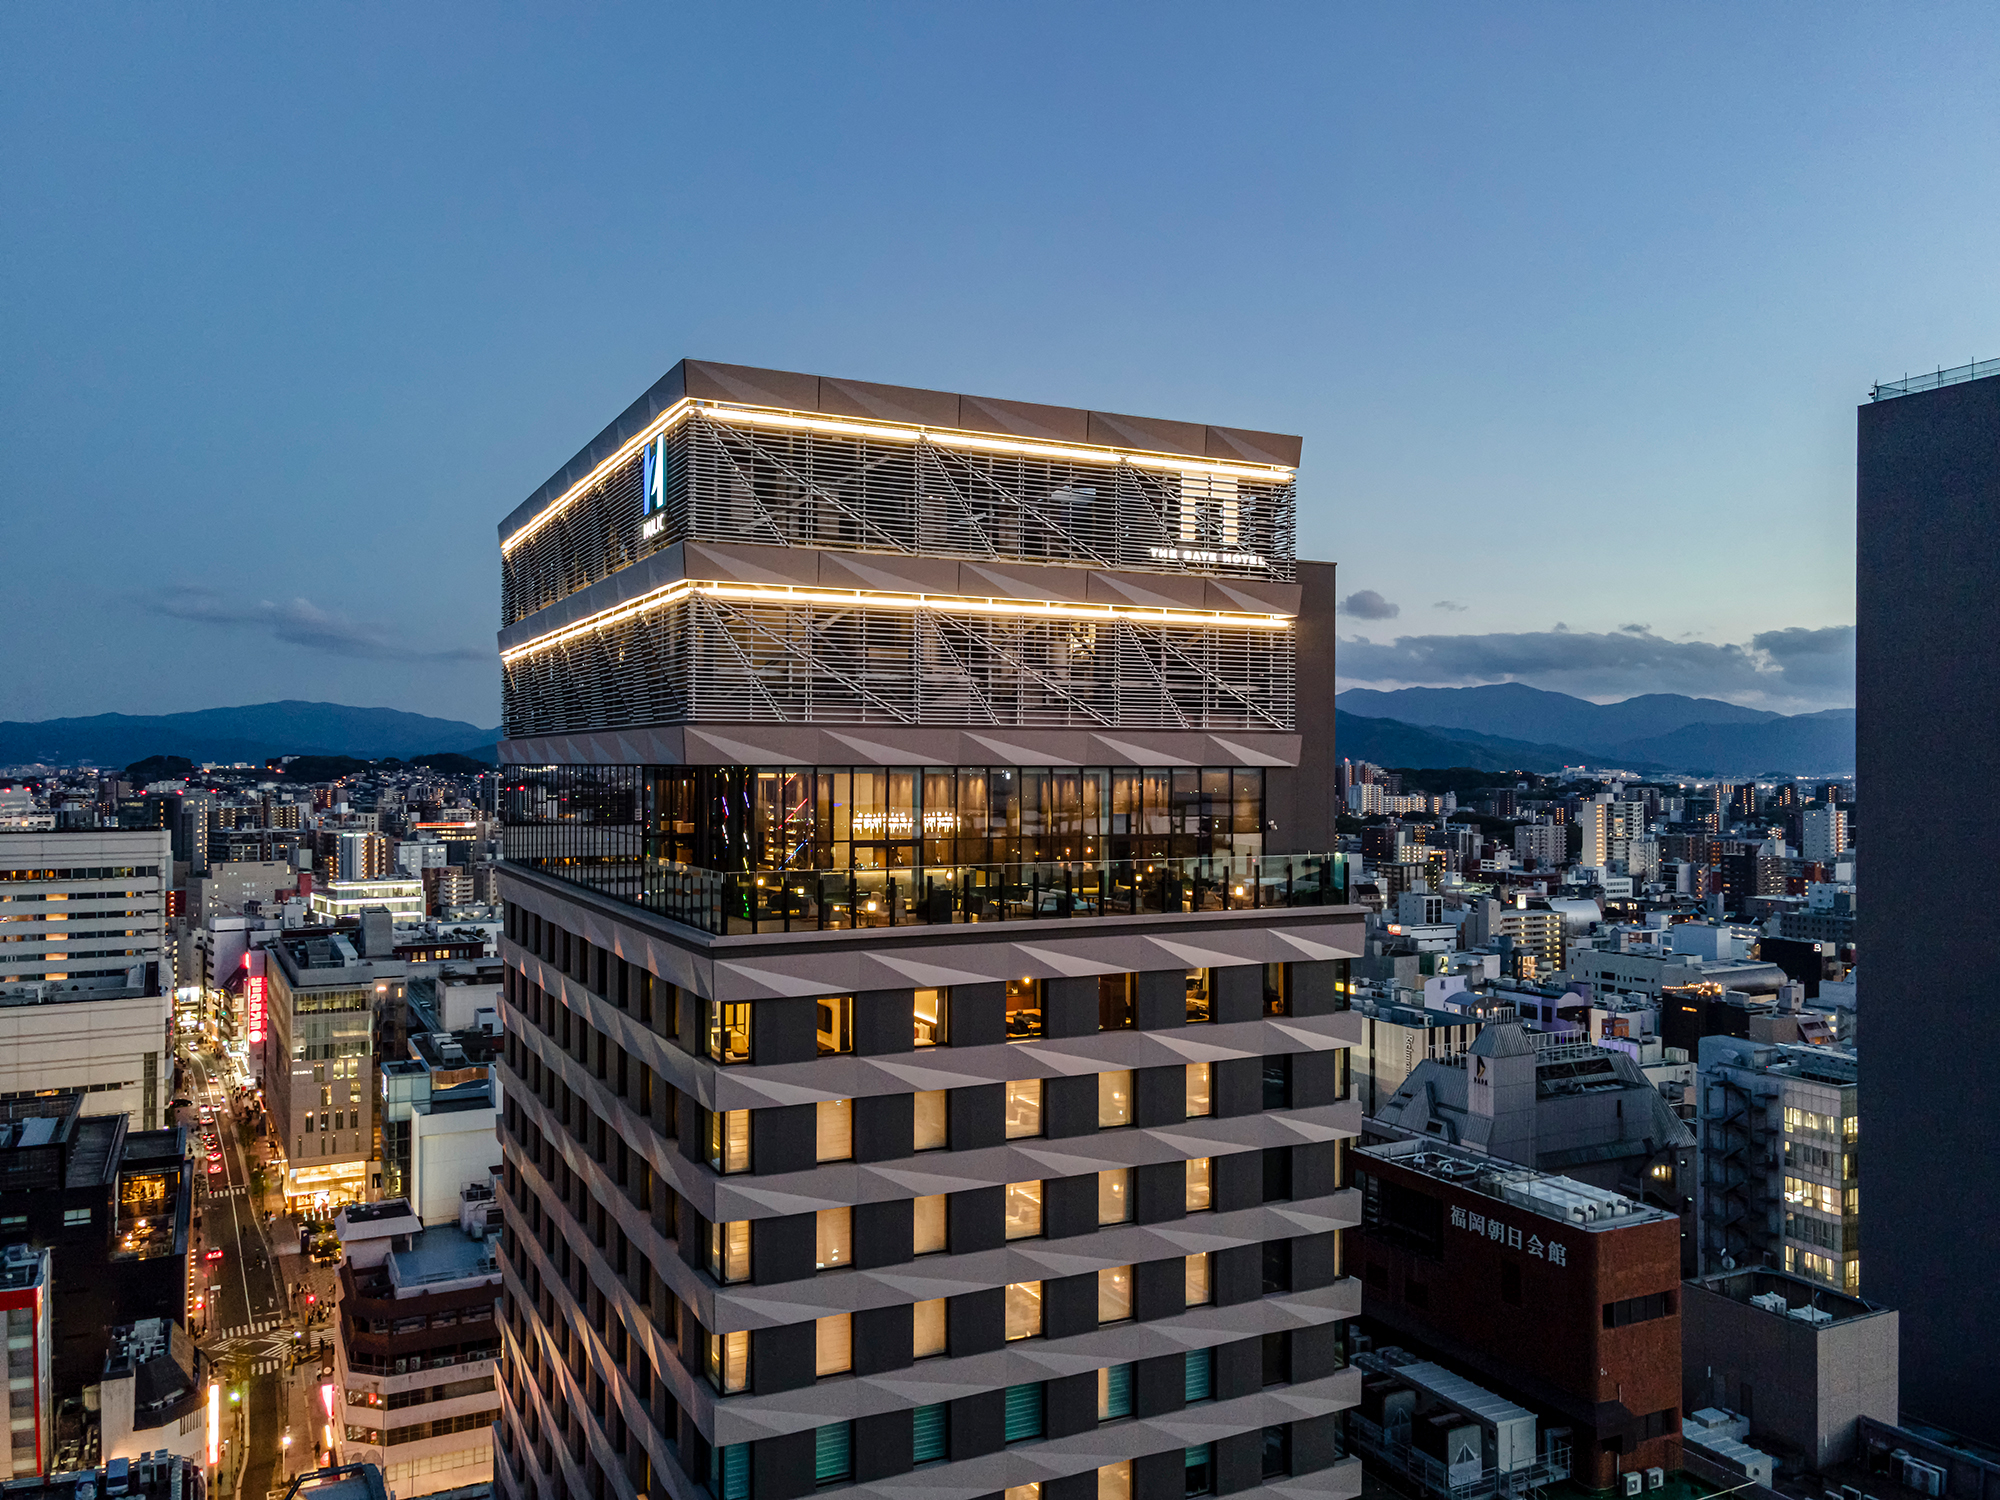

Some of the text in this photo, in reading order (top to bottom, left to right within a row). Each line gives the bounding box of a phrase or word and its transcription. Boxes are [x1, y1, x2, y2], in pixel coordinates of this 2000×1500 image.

[643, 513, 664, 540] HULIC
[1150, 547, 1266, 566] THE GATE HOTEL
[1450, 1204, 1567, 1267] 福岡朝日会館
